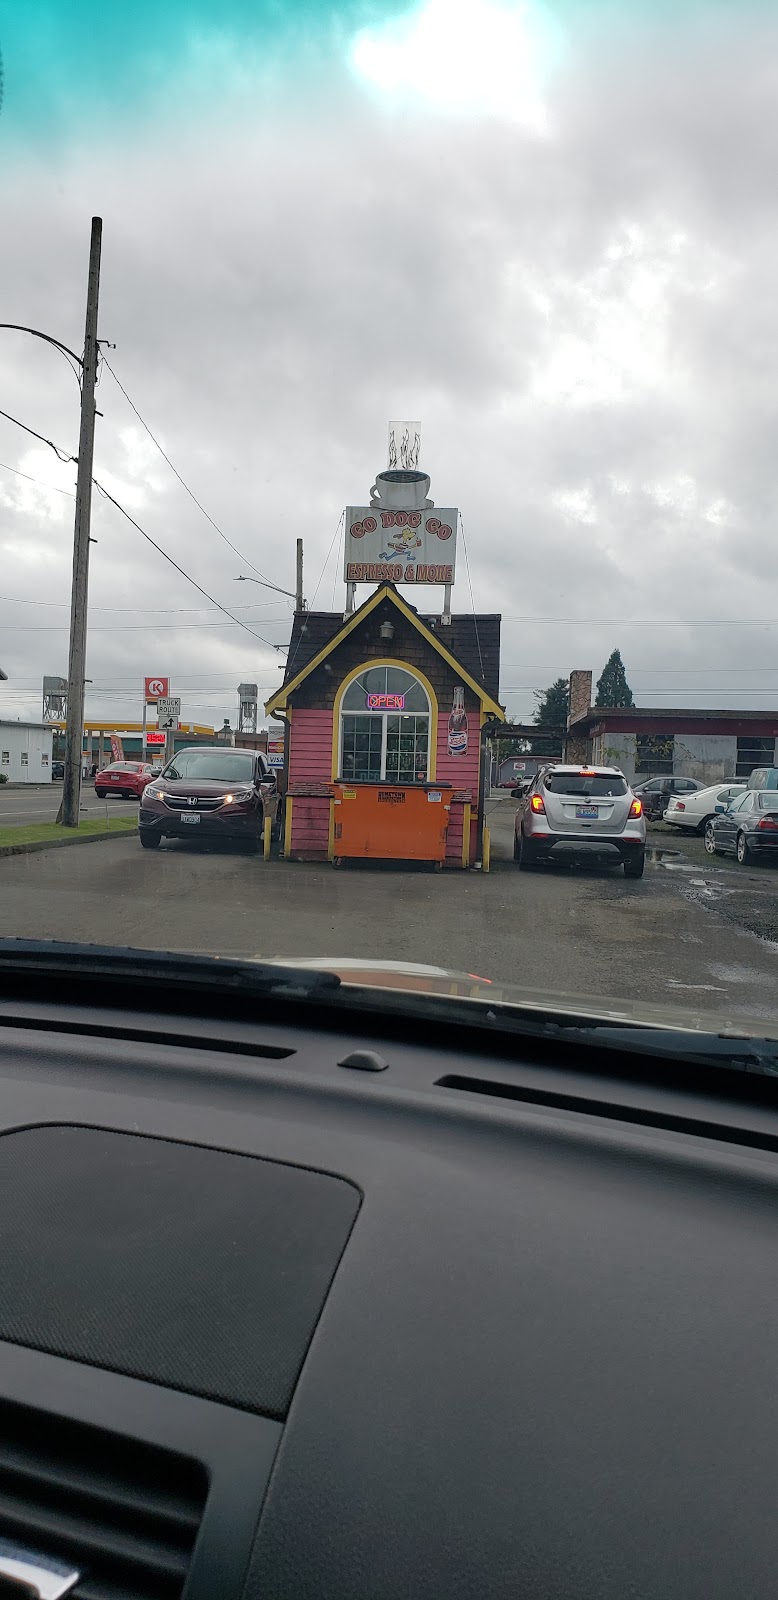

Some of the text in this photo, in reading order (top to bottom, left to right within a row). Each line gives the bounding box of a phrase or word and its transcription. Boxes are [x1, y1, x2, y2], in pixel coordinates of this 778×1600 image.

[350, 511, 453, 540] GO DOG GO
[347, 562, 453, 582] ESPRESSO & MORE
[370, 695, 403, 707] OPEN
